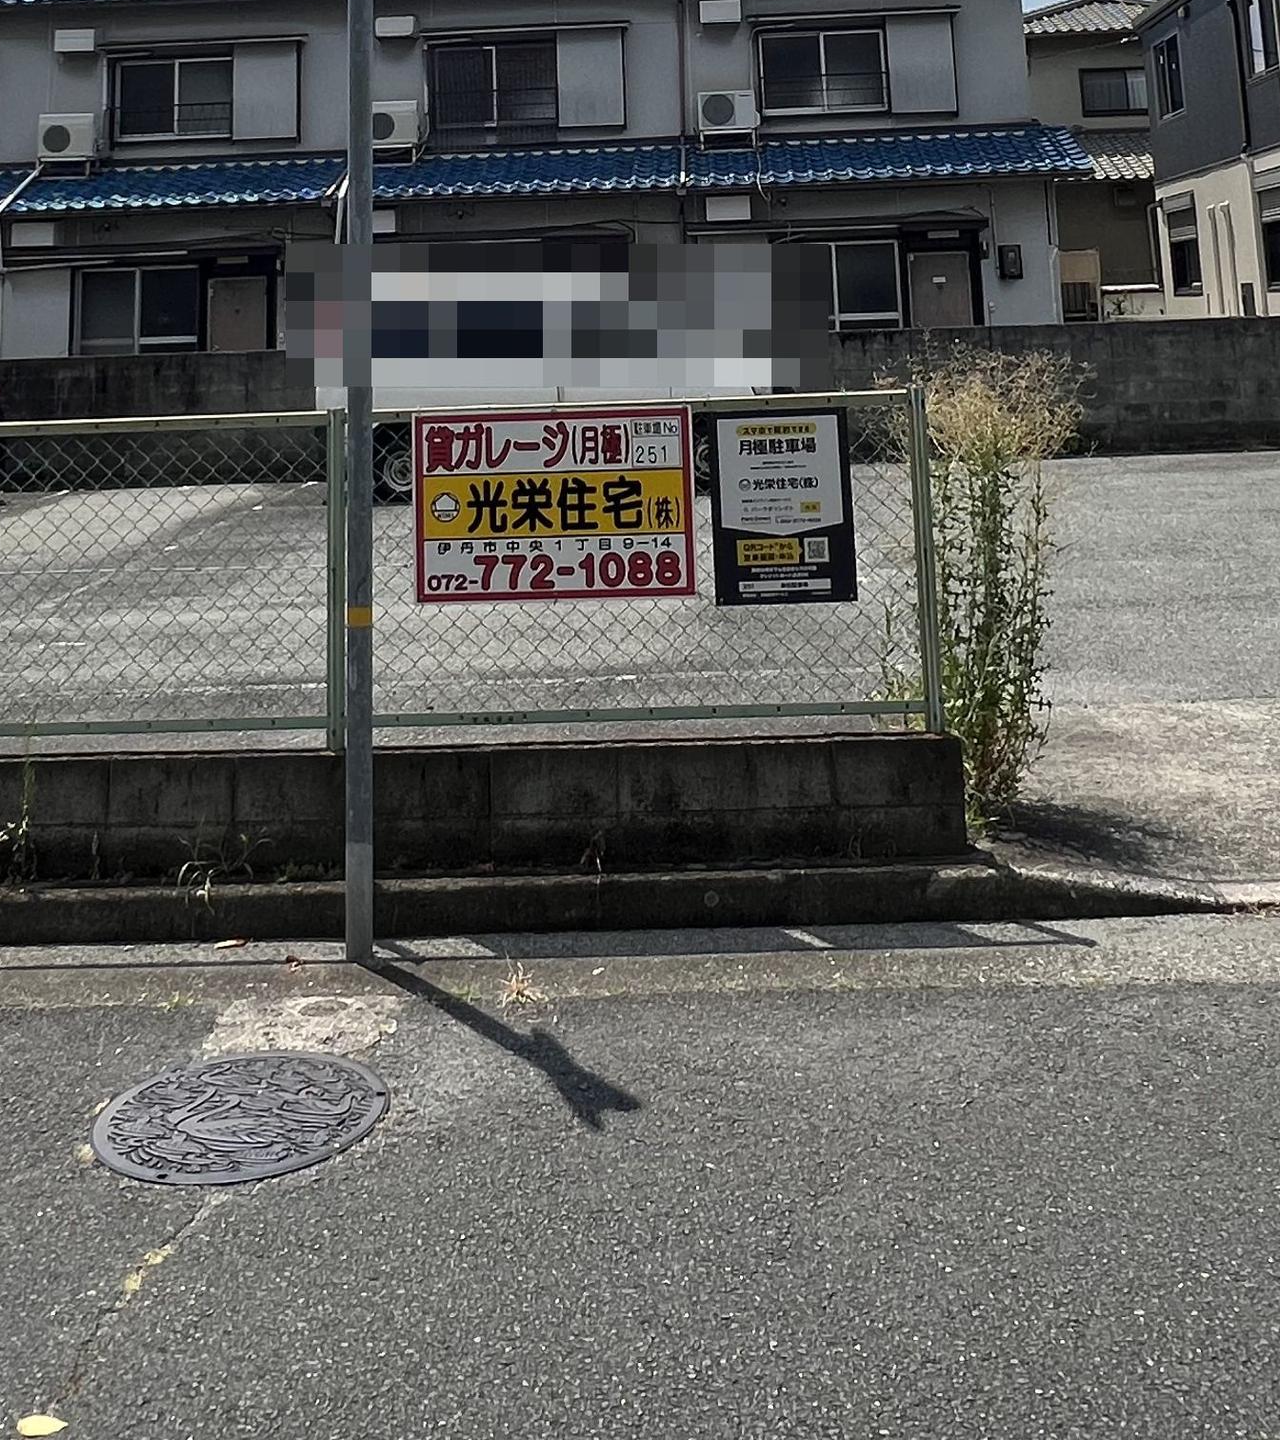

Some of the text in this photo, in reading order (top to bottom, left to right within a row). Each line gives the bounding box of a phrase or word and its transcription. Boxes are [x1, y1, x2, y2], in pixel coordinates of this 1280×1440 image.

[635, 445, 667, 464] 251
[466, 475, 680, 534] 光栄住宅(株)
[427, 550, 682, 591] 072-772-1088
